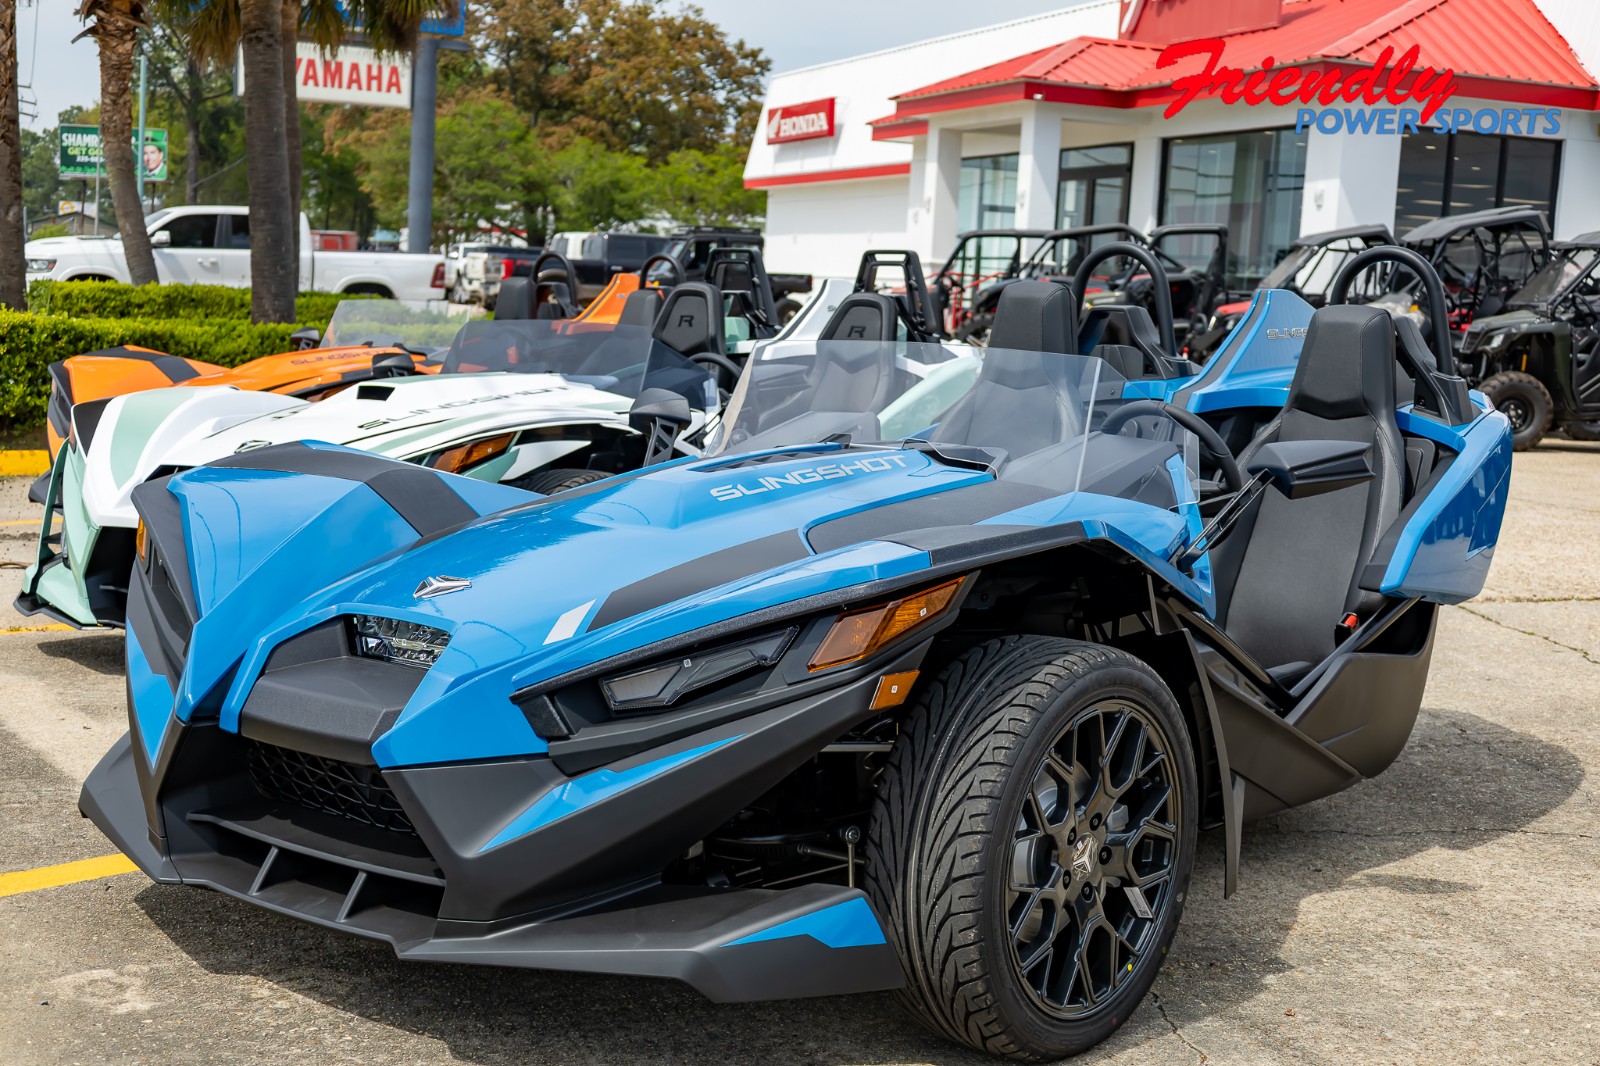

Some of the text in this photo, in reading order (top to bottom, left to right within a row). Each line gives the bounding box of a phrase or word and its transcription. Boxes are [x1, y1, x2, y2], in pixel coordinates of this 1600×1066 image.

[779, 112, 828, 136] HONDA
[62, 133, 104, 147] SHAMR
[678, 314, 694, 328] R
[847, 325, 867, 339] R
[356, 385, 569, 431] SLINGSHOT
[709, 455, 908, 502] SLINGSHOT
